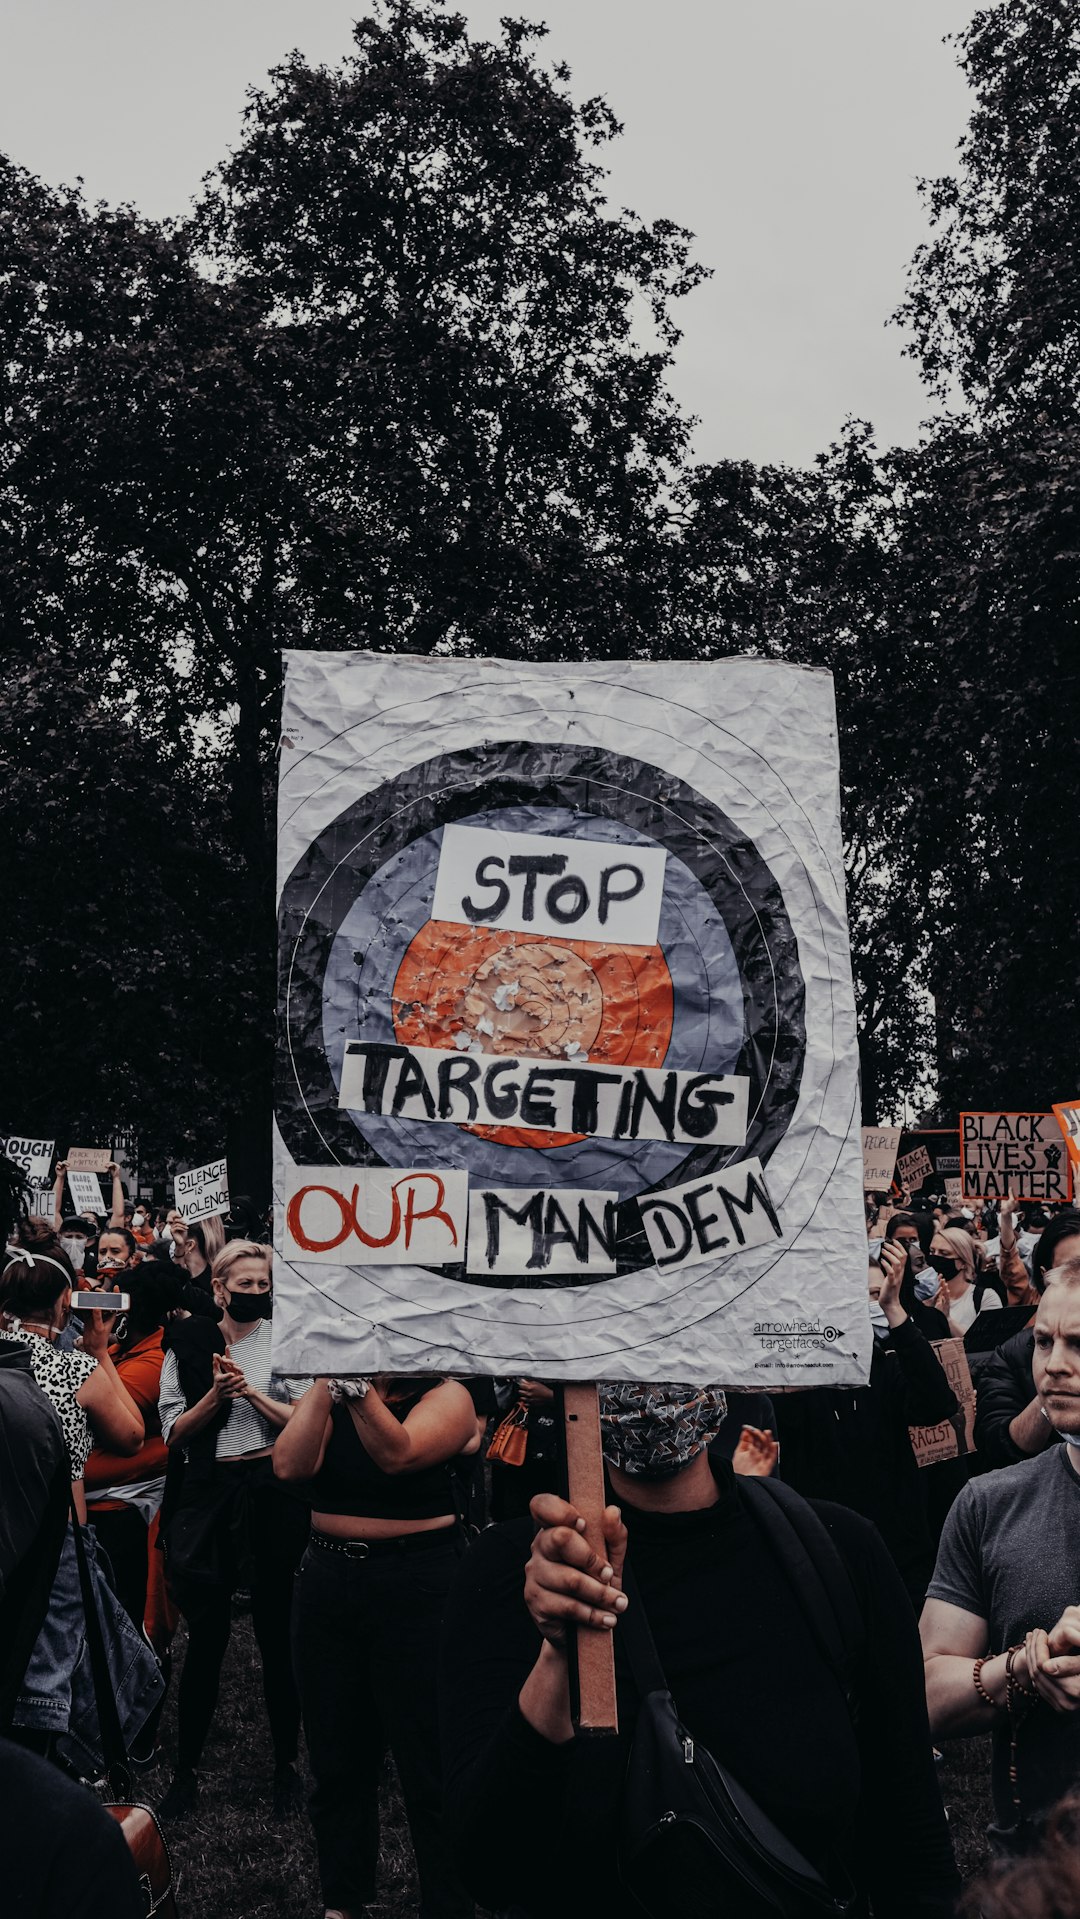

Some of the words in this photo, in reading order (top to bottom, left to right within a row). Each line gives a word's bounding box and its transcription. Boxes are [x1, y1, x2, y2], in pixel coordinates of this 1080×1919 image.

[461, 854, 645, 925] STOP
[346, 1043, 735, 1141] TARGETING
[963, 1115, 1045, 1142] BLACK
[898, 1147, 928, 1171] BLACK
[963, 1143, 1037, 1170] LIVES
[178, 1163, 227, 1192] SILENCE
[903, 1163, 932, 1184] MATTER
[963, 1170, 1067, 1200] MATTER
[177, 1190, 229, 1217] VIOLENCE
[287, 1173, 458, 1253] OUR
[482, 1191, 619, 1269] MAN
[638, 1171, 783, 1267] DEM
[754, 1318, 820, 1332] arrowhead
[760, 1336, 825, 1352] targetfaces
[909, 1423, 950, 1450] RACIST
